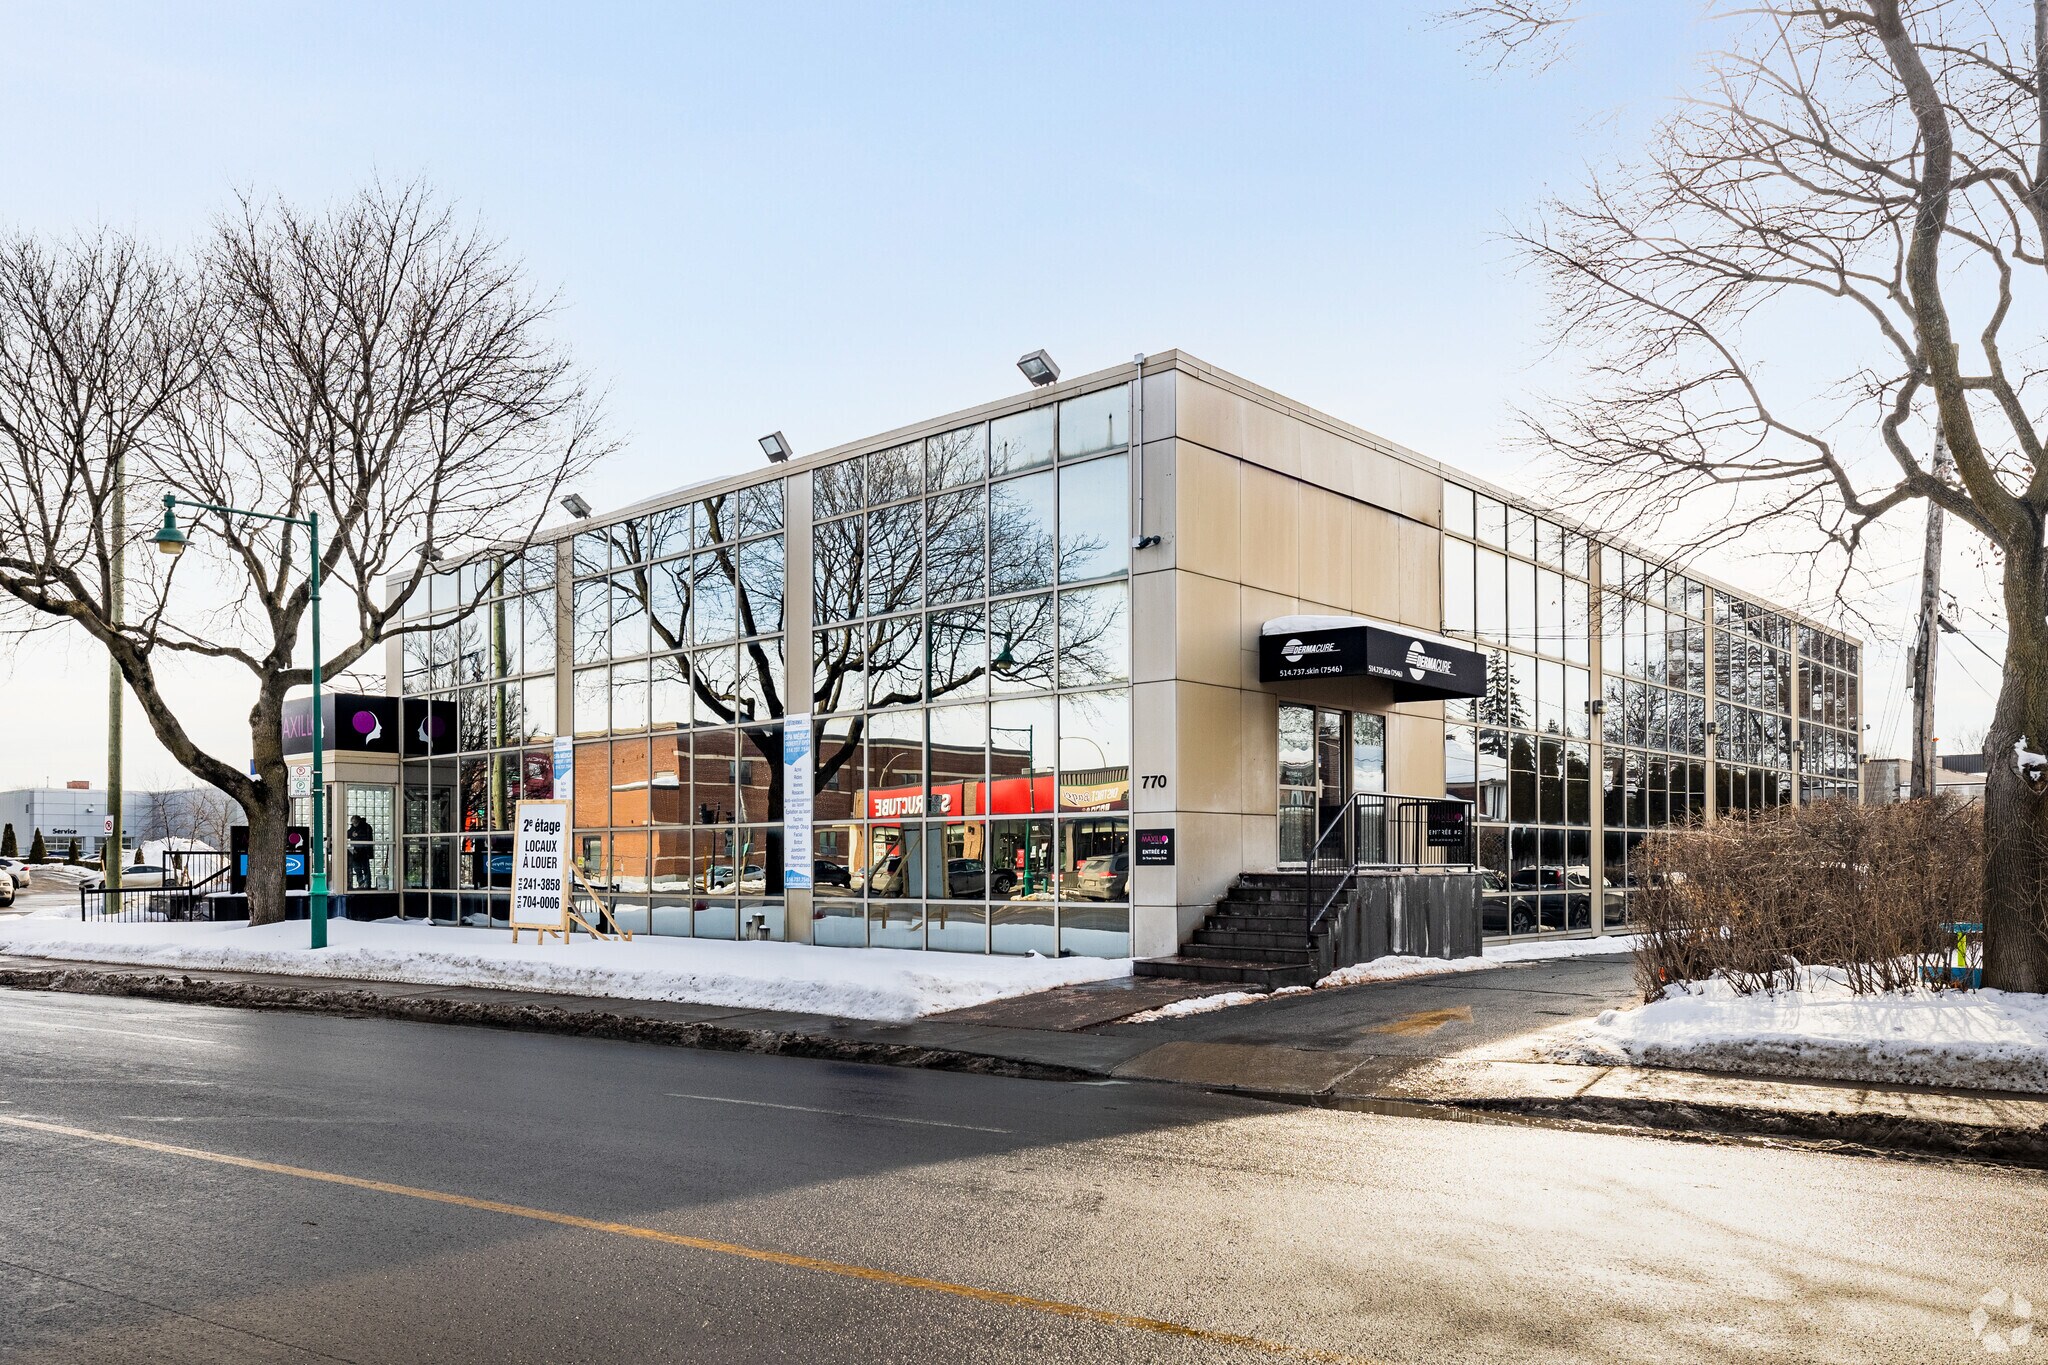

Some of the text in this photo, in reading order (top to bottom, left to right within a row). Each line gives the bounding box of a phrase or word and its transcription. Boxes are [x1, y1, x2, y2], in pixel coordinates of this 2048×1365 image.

[1293, 643, 1336, 655] DERMACURE
[1279, 665, 1343, 677] 514.737.skin (7546)
[1416, 655, 1453, 674] DERMACURE
[282, 714, 314, 740] AXILL
[1141, 774, 1167, 789] 770
[534, 818, 561, 836] étage
[525, 840, 557, 853] LOCAUX
[522, 853, 558, 869] À LOUER
[523, 877, 561, 891] 241-3858
[522, 895, 560, 909] 704-0006
